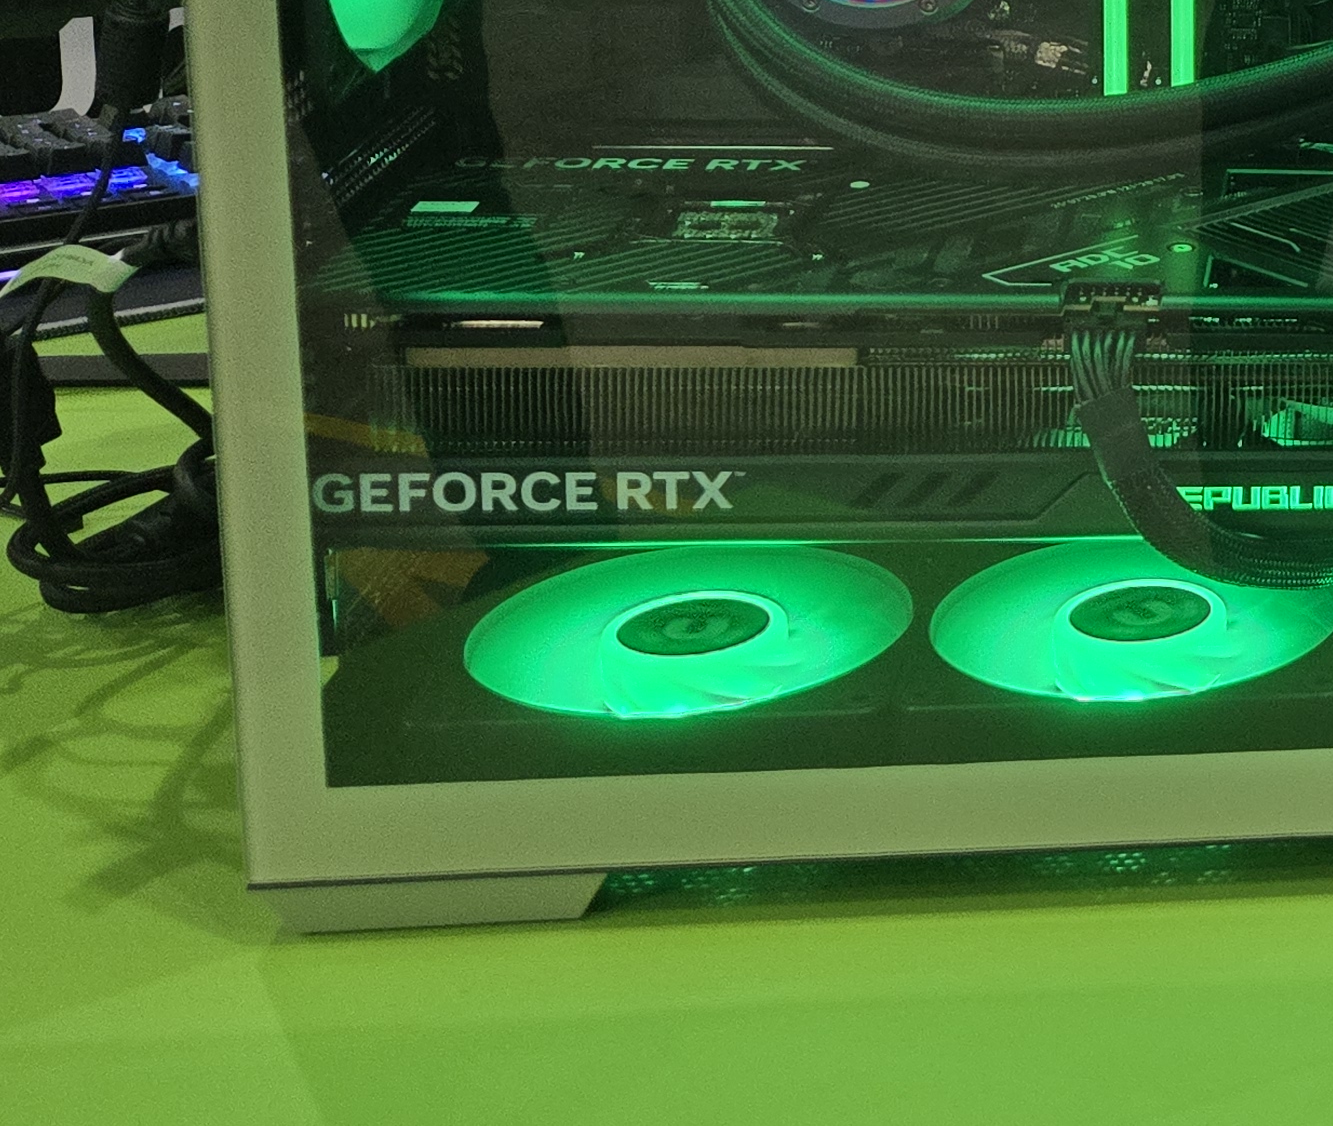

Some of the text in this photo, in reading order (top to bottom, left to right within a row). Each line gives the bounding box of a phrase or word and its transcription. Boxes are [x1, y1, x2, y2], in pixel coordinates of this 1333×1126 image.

[455, 157, 807, 171] GEFORCE RTX
[312, 471, 599, 514] GEFORCE
